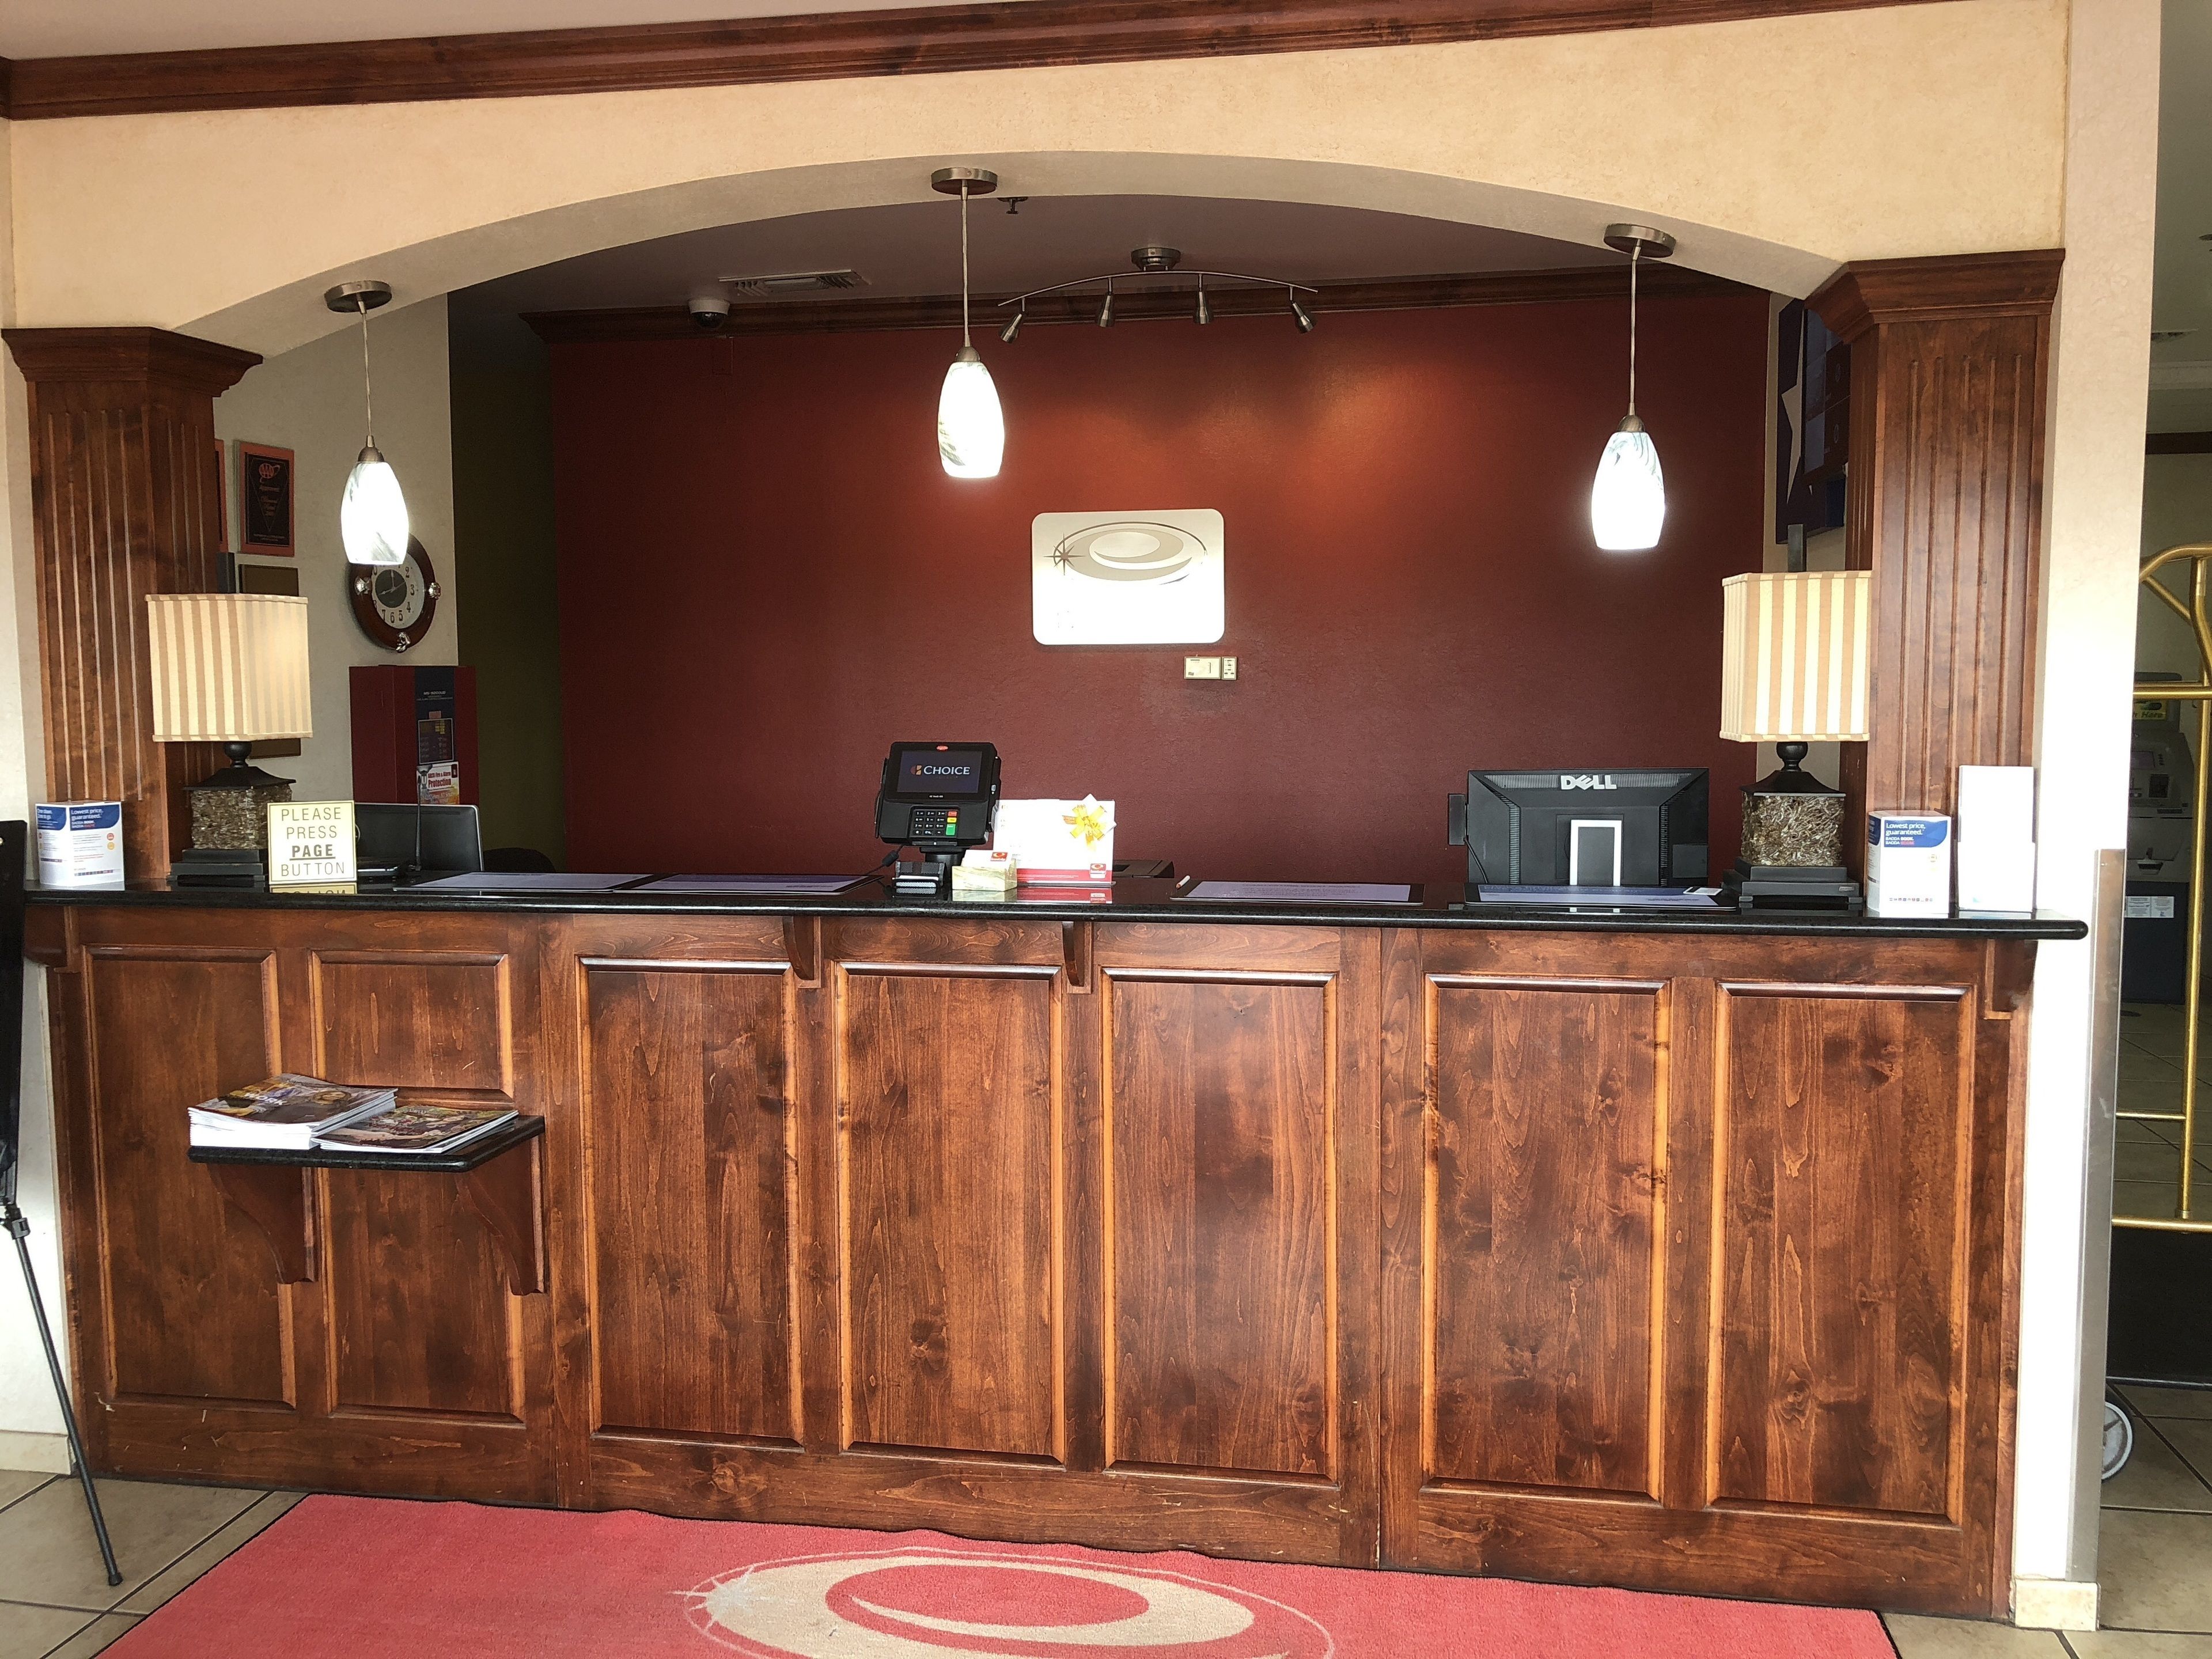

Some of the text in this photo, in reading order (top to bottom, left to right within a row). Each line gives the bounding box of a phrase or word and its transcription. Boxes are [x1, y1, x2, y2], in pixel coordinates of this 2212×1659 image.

[405, 566, 410, 578] 2
[410, 584, 415, 596] 3
[406, 601, 411, 613] 4
[382, 609, 386, 622] 7
[390, 612, 395, 623] 6
[399, 610, 403, 622] 5
[428, 778, 452, 788] Protection
[1560, 774, 1618, 790] DELL
[281, 807, 342, 821] PLEASE
[286, 825, 337, 839] PRESS
[291, 844, 333, 858] PAGE
[281, 862, 345, 877] BUTTON
[244, 1092, 288, 1106] WORK
